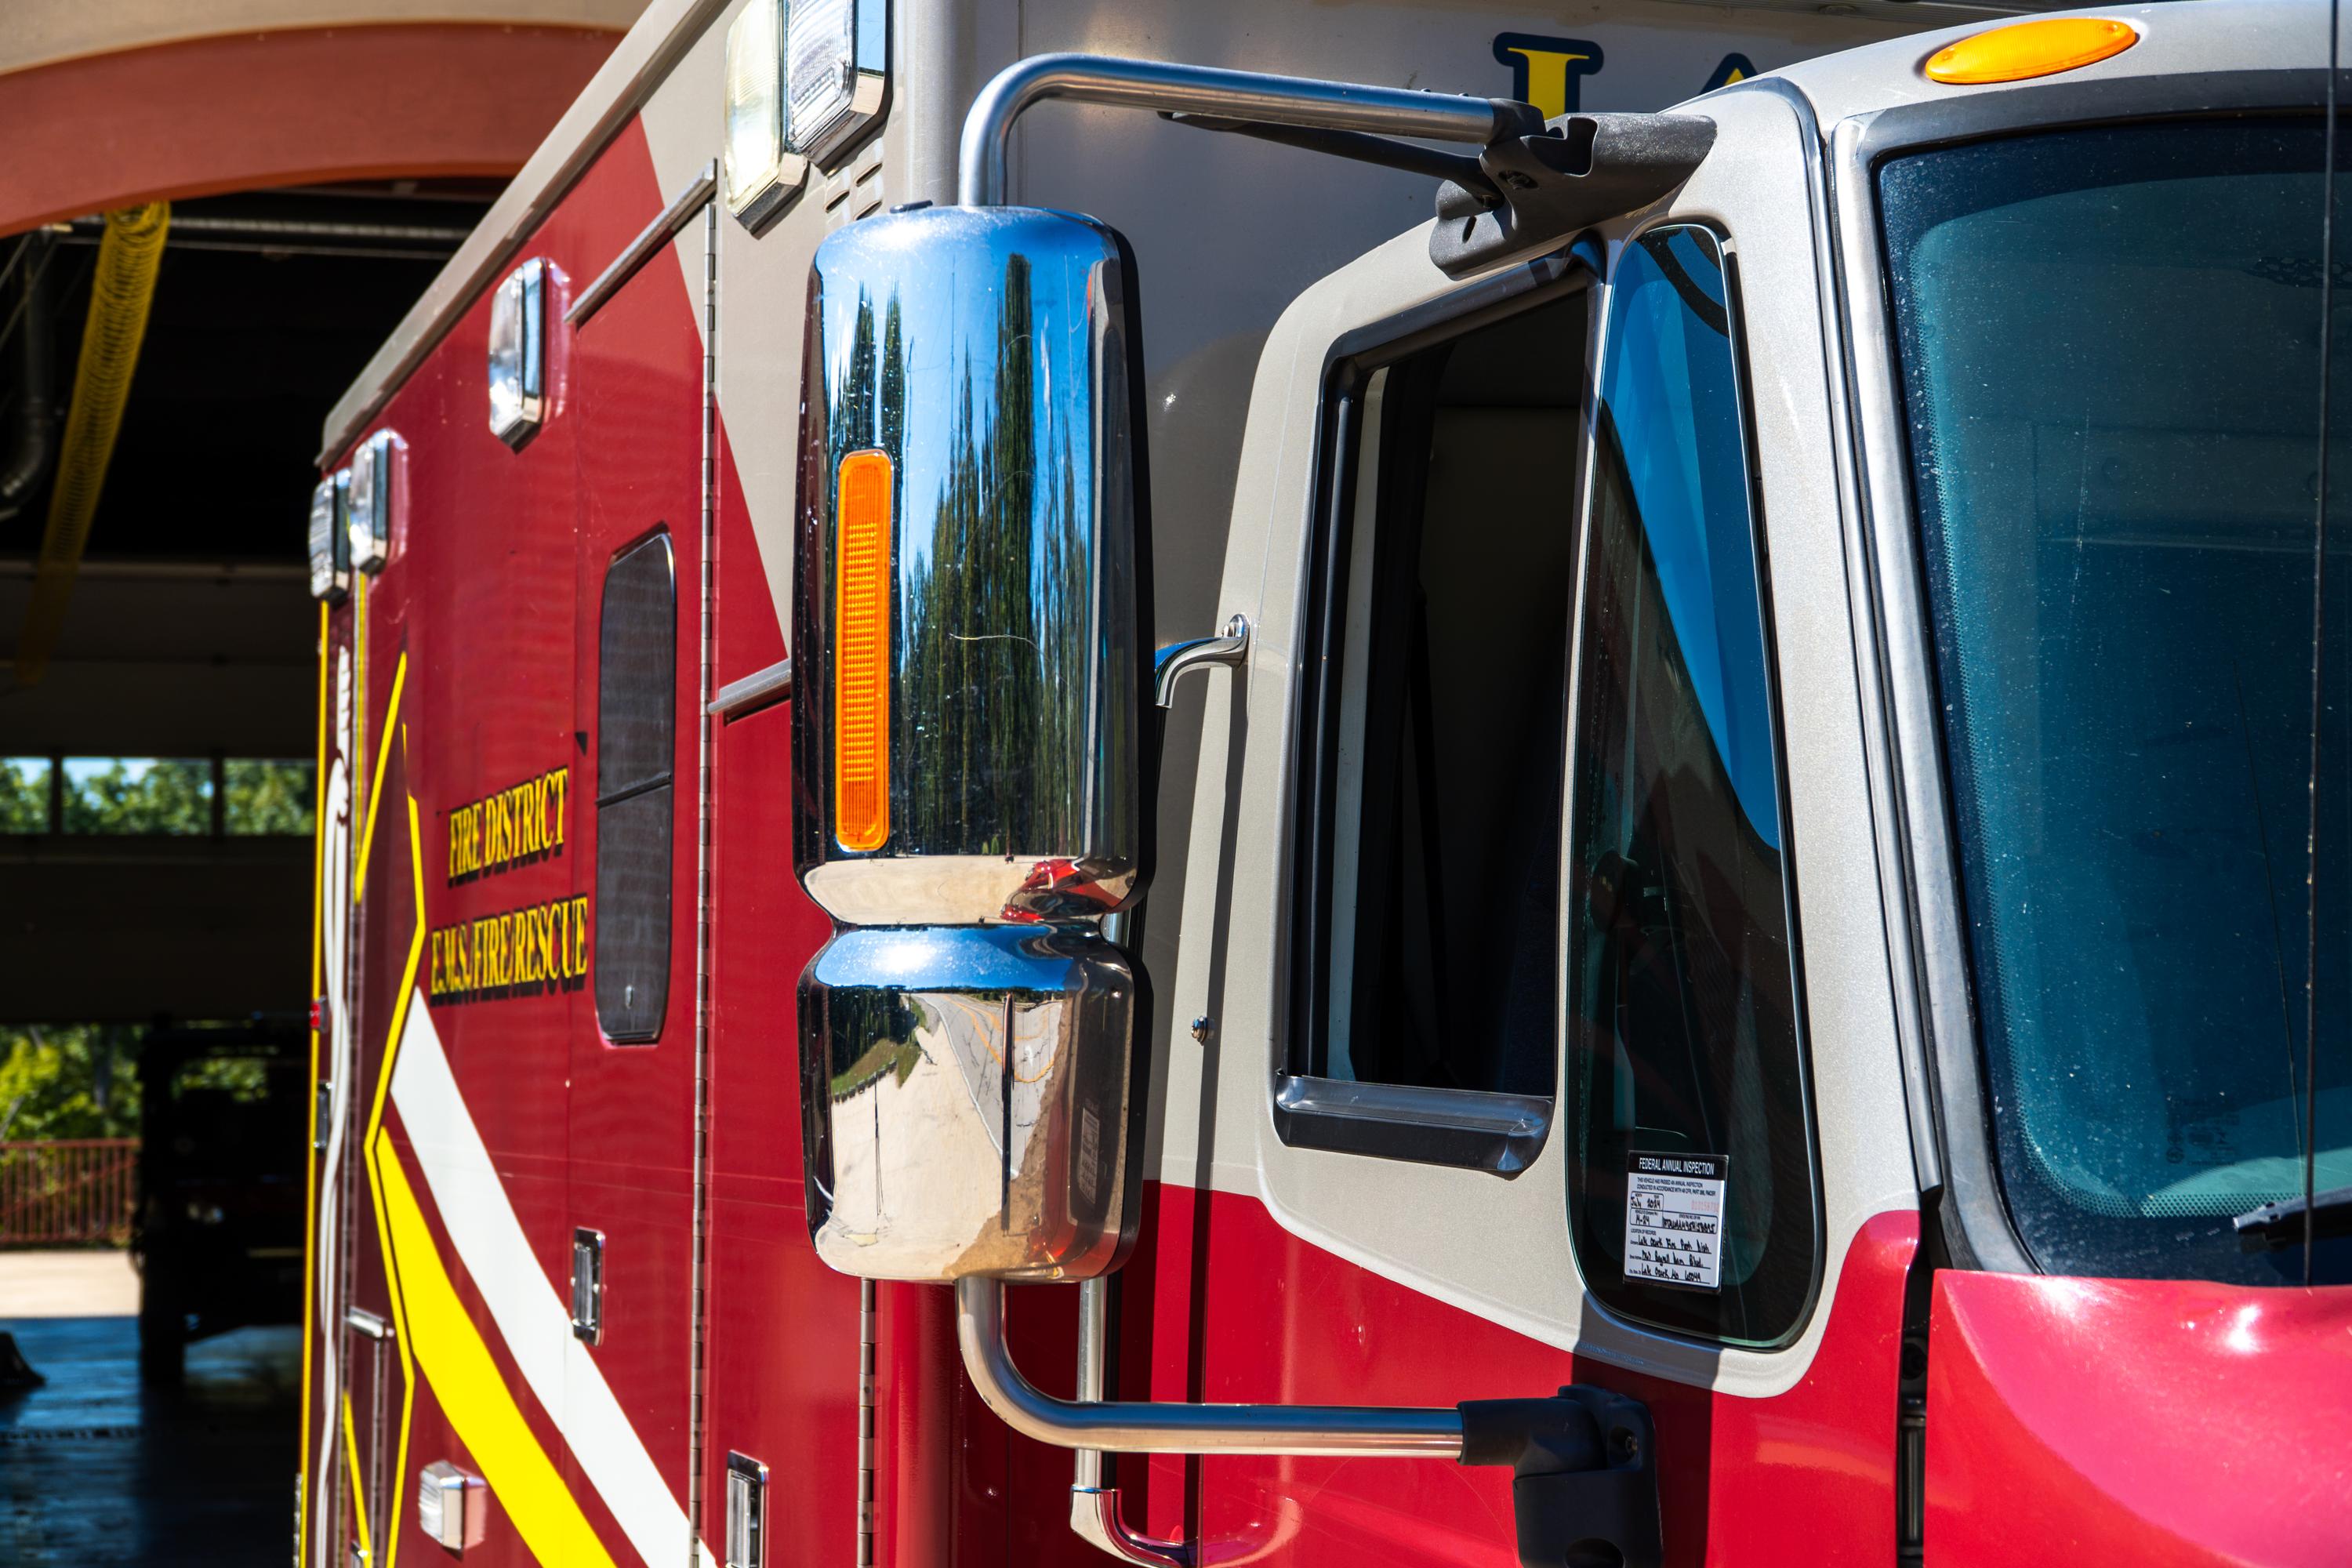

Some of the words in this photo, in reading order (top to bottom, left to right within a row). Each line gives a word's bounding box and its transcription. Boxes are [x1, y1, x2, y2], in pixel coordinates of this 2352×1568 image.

[448, 801, 483, 883] FIRE
[484, 767, 568, 870] DISTRICT
[1639, 1157, 1661, 1171] FEDERAL
[1662, 1160, 1682, 1173] ANNUAL
[1683, 1161, 1715, 1175] INSPECTION
